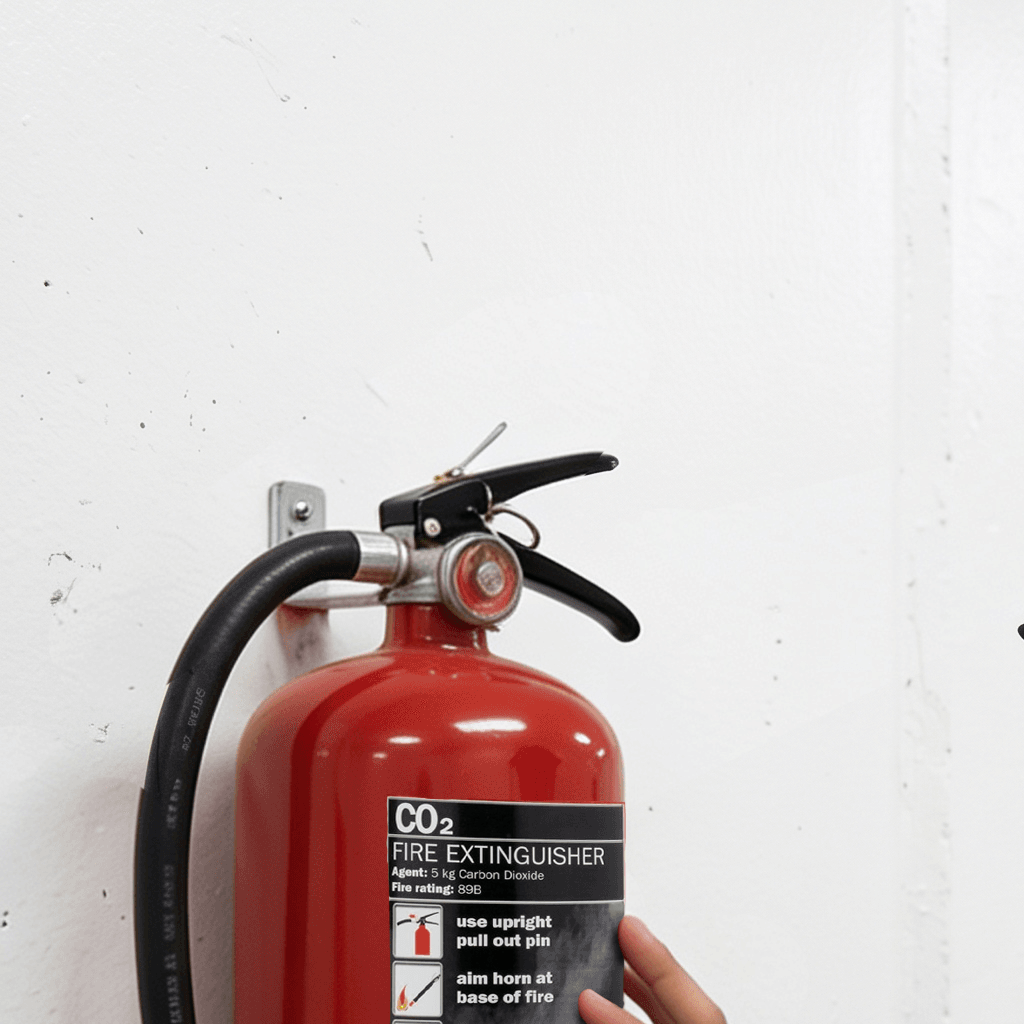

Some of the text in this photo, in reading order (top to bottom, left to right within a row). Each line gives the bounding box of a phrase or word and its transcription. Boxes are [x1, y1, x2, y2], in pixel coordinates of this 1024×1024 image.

[395, 802, 454, 835] CO2
[392, 841, 605, 866] FIRE EXTINGUISHER
[392, 866, 545, 881] Agent: 5 kg Carbon Dioxide
[392, 882, 482, 896] Fire rating: 89B
[456, 915, 553, 931] use upright
[456, 934, 551, 949] pull out pin
[456, 972, 553, 985] aim horn at
[456, 990, 555, 1003] base of fire
